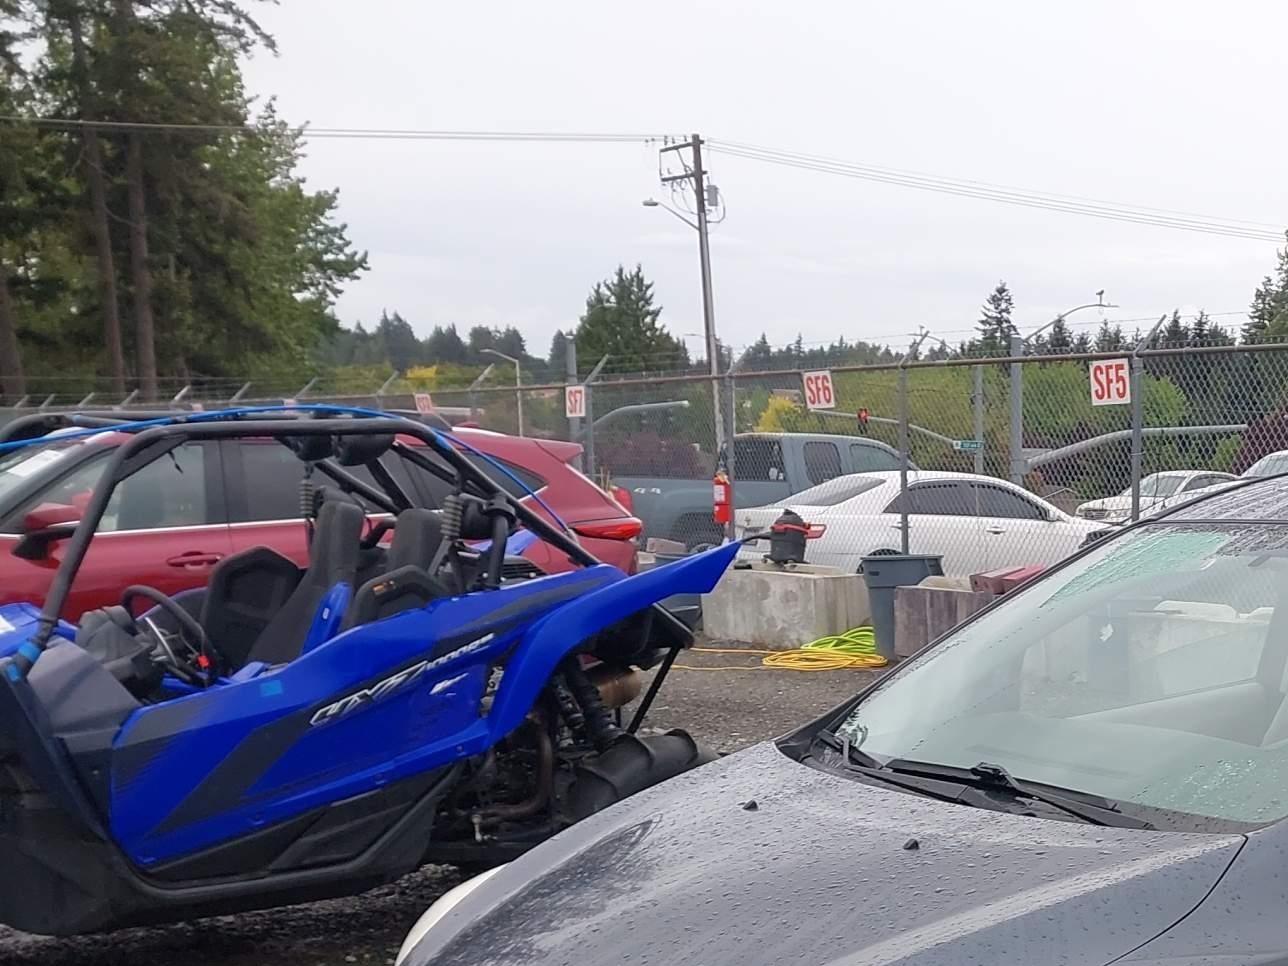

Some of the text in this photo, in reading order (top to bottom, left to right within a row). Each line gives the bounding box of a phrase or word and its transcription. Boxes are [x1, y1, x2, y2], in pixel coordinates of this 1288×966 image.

[806, 374, 832, 405] SF6
[1093, 363, 1127, 400] SF5
[567, 389, 583, 414] SF7
